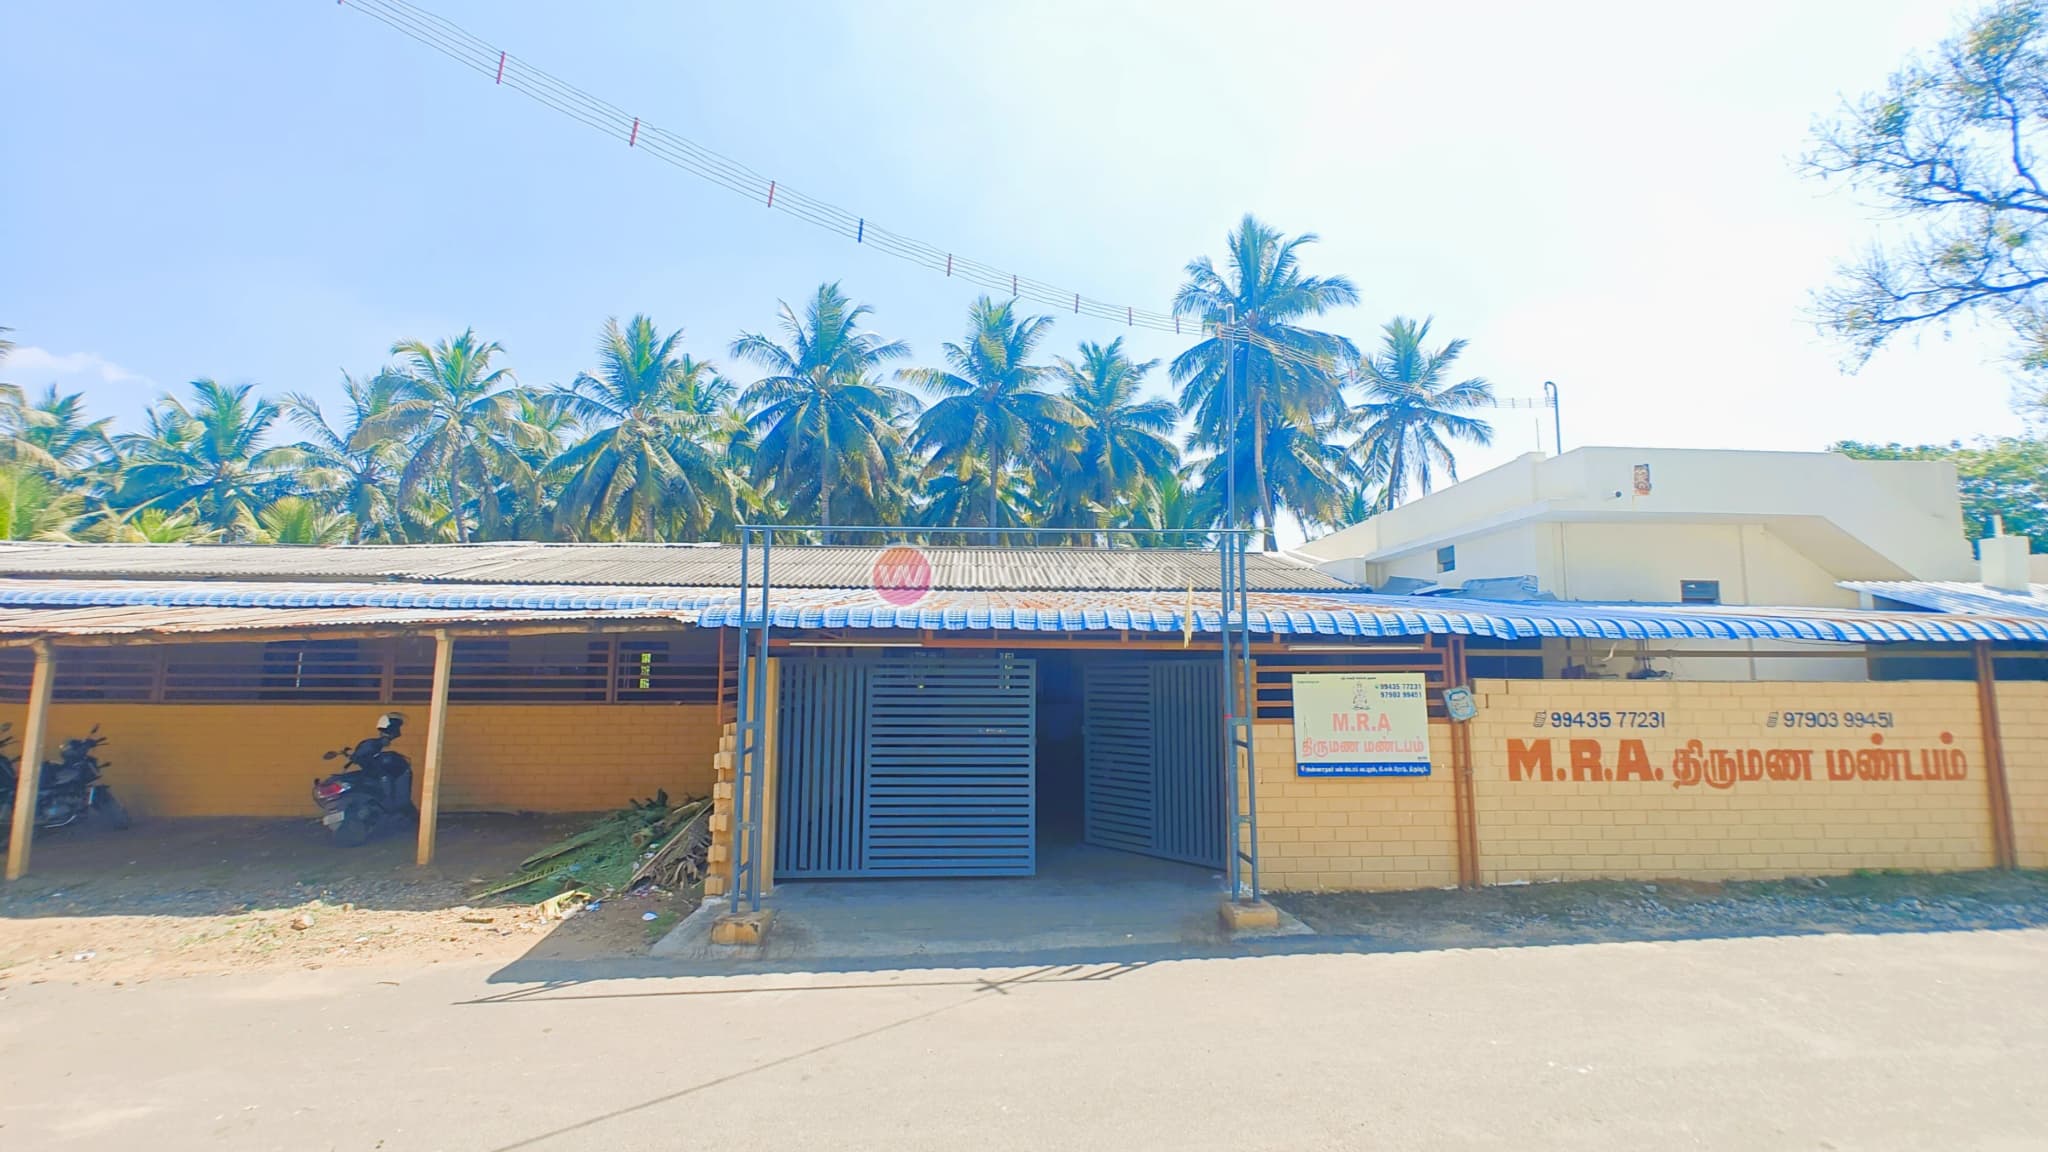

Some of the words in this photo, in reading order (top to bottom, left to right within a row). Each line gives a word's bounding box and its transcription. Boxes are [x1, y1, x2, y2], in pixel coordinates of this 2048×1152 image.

[1332, 713, 1392, 731] M.R.A
[1550, 711, 1611, 729] 99435
[1616, 711, 1666, 729] 77231
[1783, 711, 1838, 729] 97903
[1844, 711, 1894, 729] 99451
[1364, 735, 1424, 753] மண்டபம்
[1506, 738, 1665, 782] M.R.A.
[1672, 738, 1813, 789] திருமண
[1825, 732, 1968, 782] மண்டபம்
